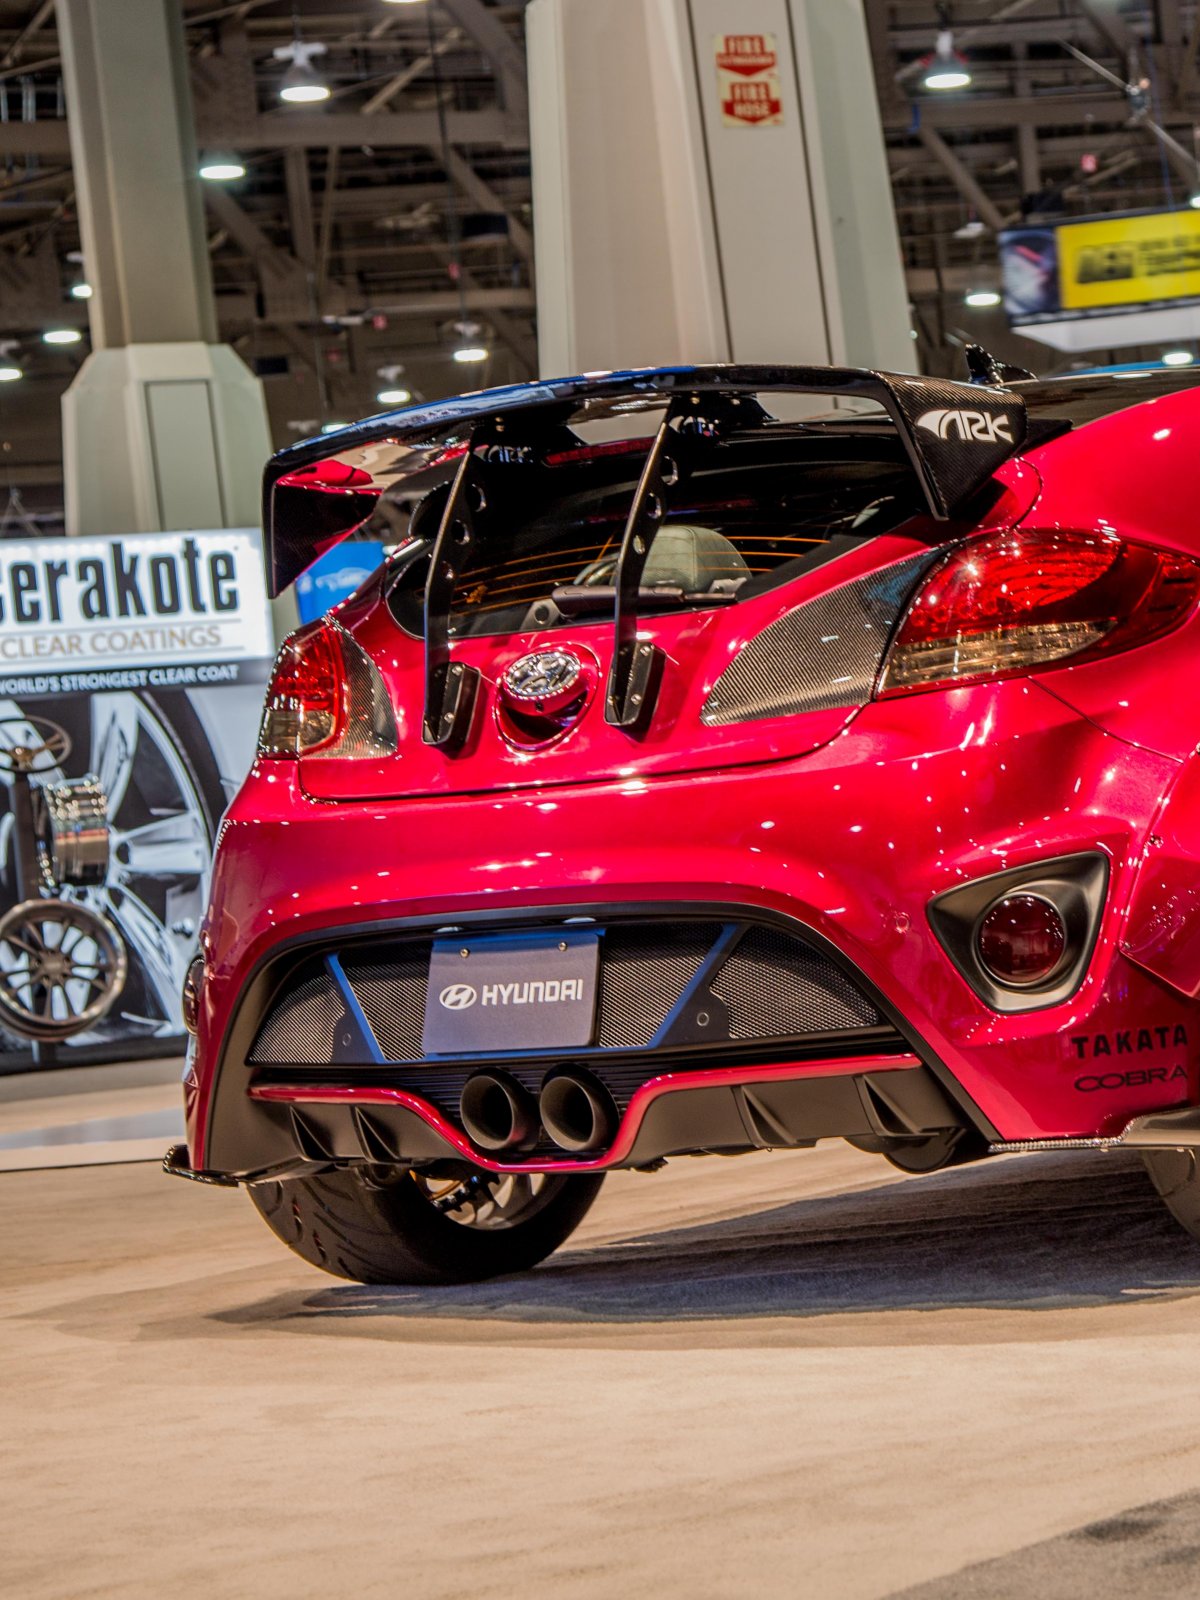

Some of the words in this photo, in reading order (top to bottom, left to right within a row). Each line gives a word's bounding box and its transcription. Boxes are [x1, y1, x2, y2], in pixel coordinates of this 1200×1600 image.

[727, 37, 761, 54] FIRE
[733, 84, 768, 100] FIRE
[917, 409, 1015, 444] ARK
[0, 537, 238, 623] erakote
[1, 636, 83, 660] CLEAR
[90, 626, 221, 654] COATINGS
[61, 670, 148, 692] STRONGEST
[149, 667, 197, 687] CLEAR
[197, 664, 239, 683] COAT
[482, 978, 583, 1006] HYUNDAI
[1071, 1024, 1188, 1059] TAKATA
[1074, 1065, 1188, 1093] COBRA
